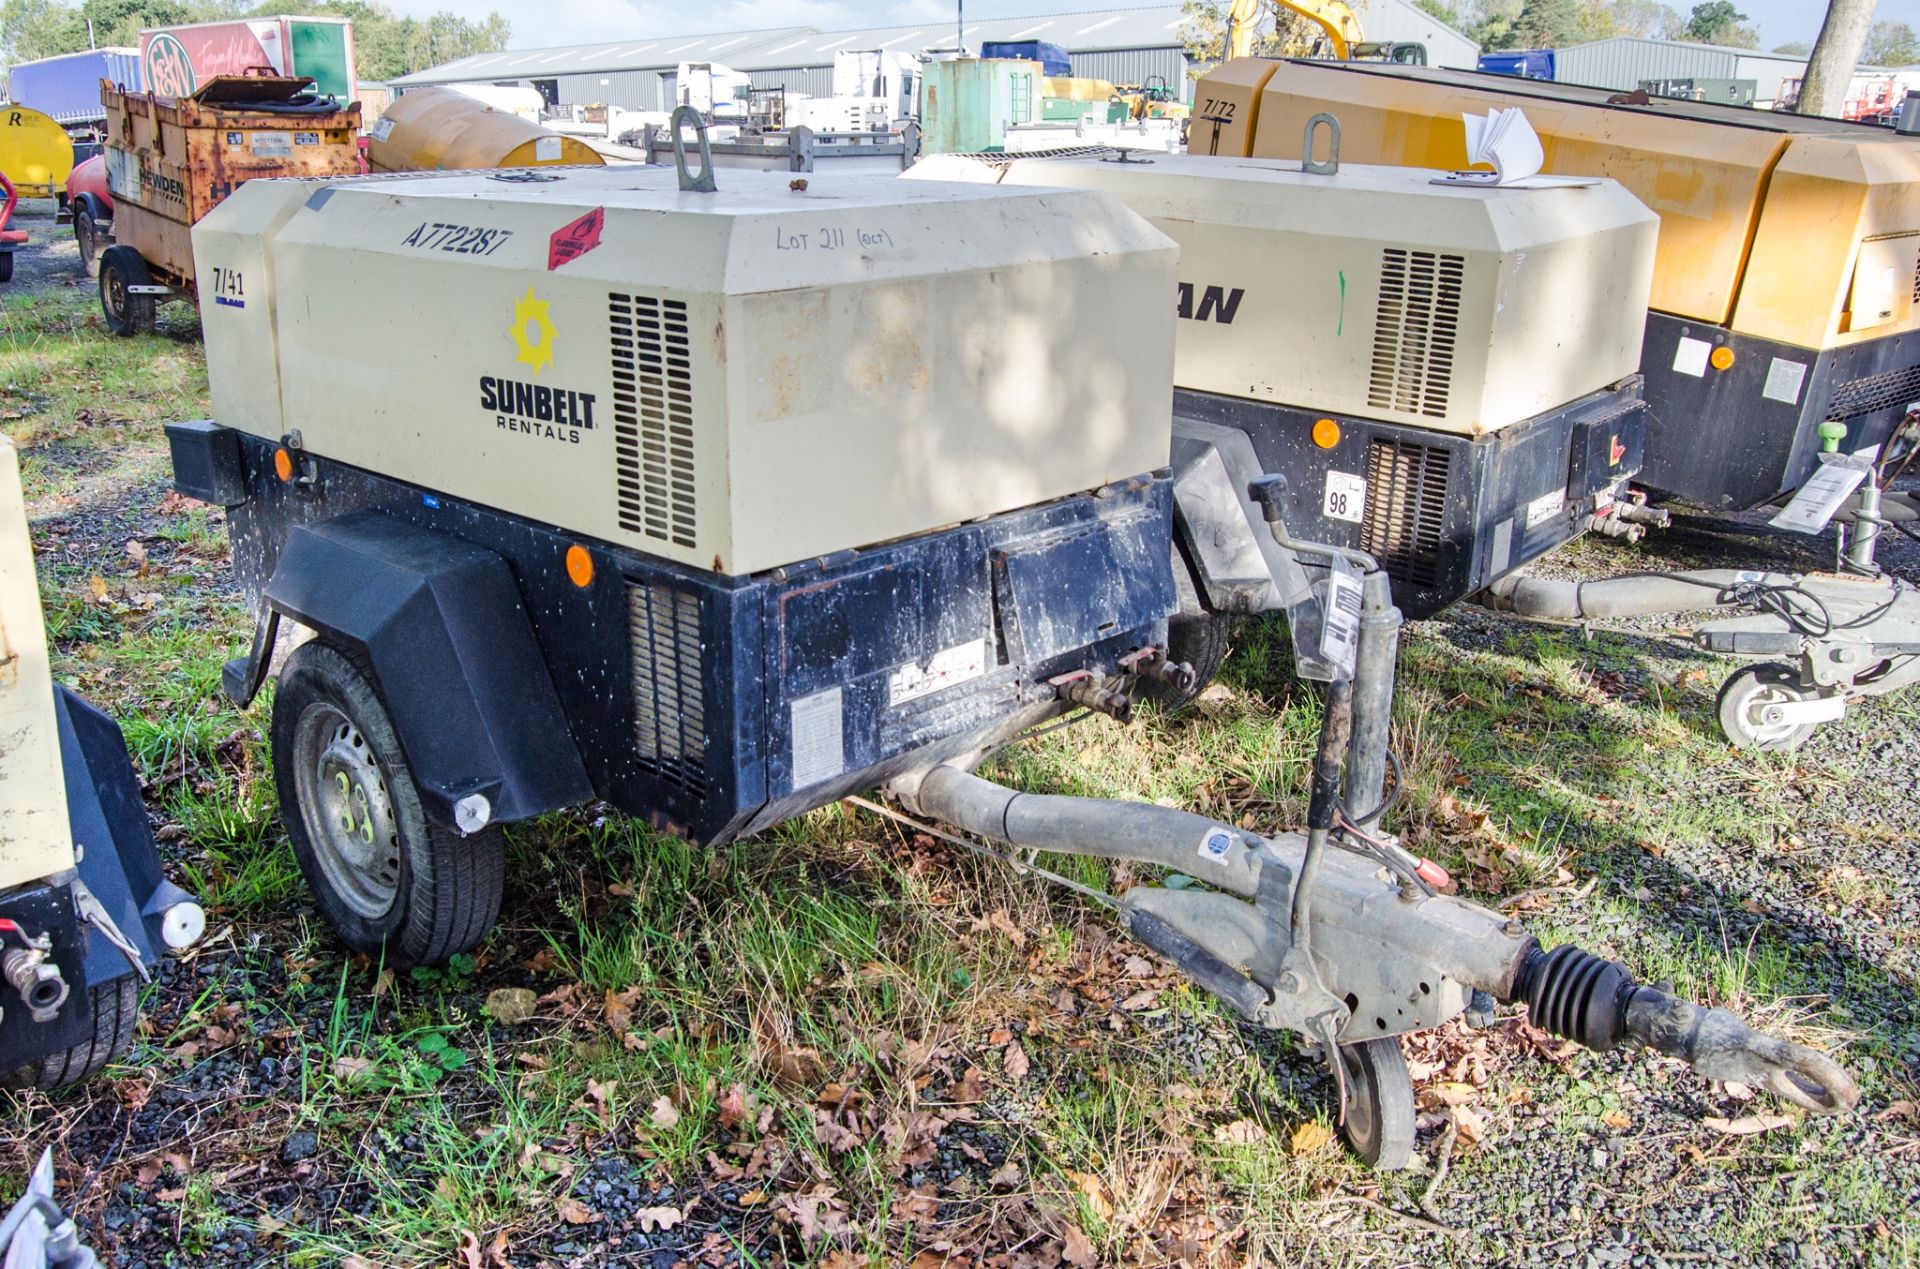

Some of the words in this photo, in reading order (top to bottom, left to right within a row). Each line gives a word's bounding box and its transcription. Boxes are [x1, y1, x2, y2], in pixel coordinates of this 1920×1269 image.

[1204, 98, 1236, 117] 7/72
[138, 168, 184, 198] HEWDEN
[401, 222, 513, 256] A772287
[819, 227, 844, 250] 211
[213, 267, 244, 295] 7/41
[480, 376, 596, 429] SUNBELT
[497, 416, 580, 444] RENTALS
[1329, 491, 1347, 515] 98
